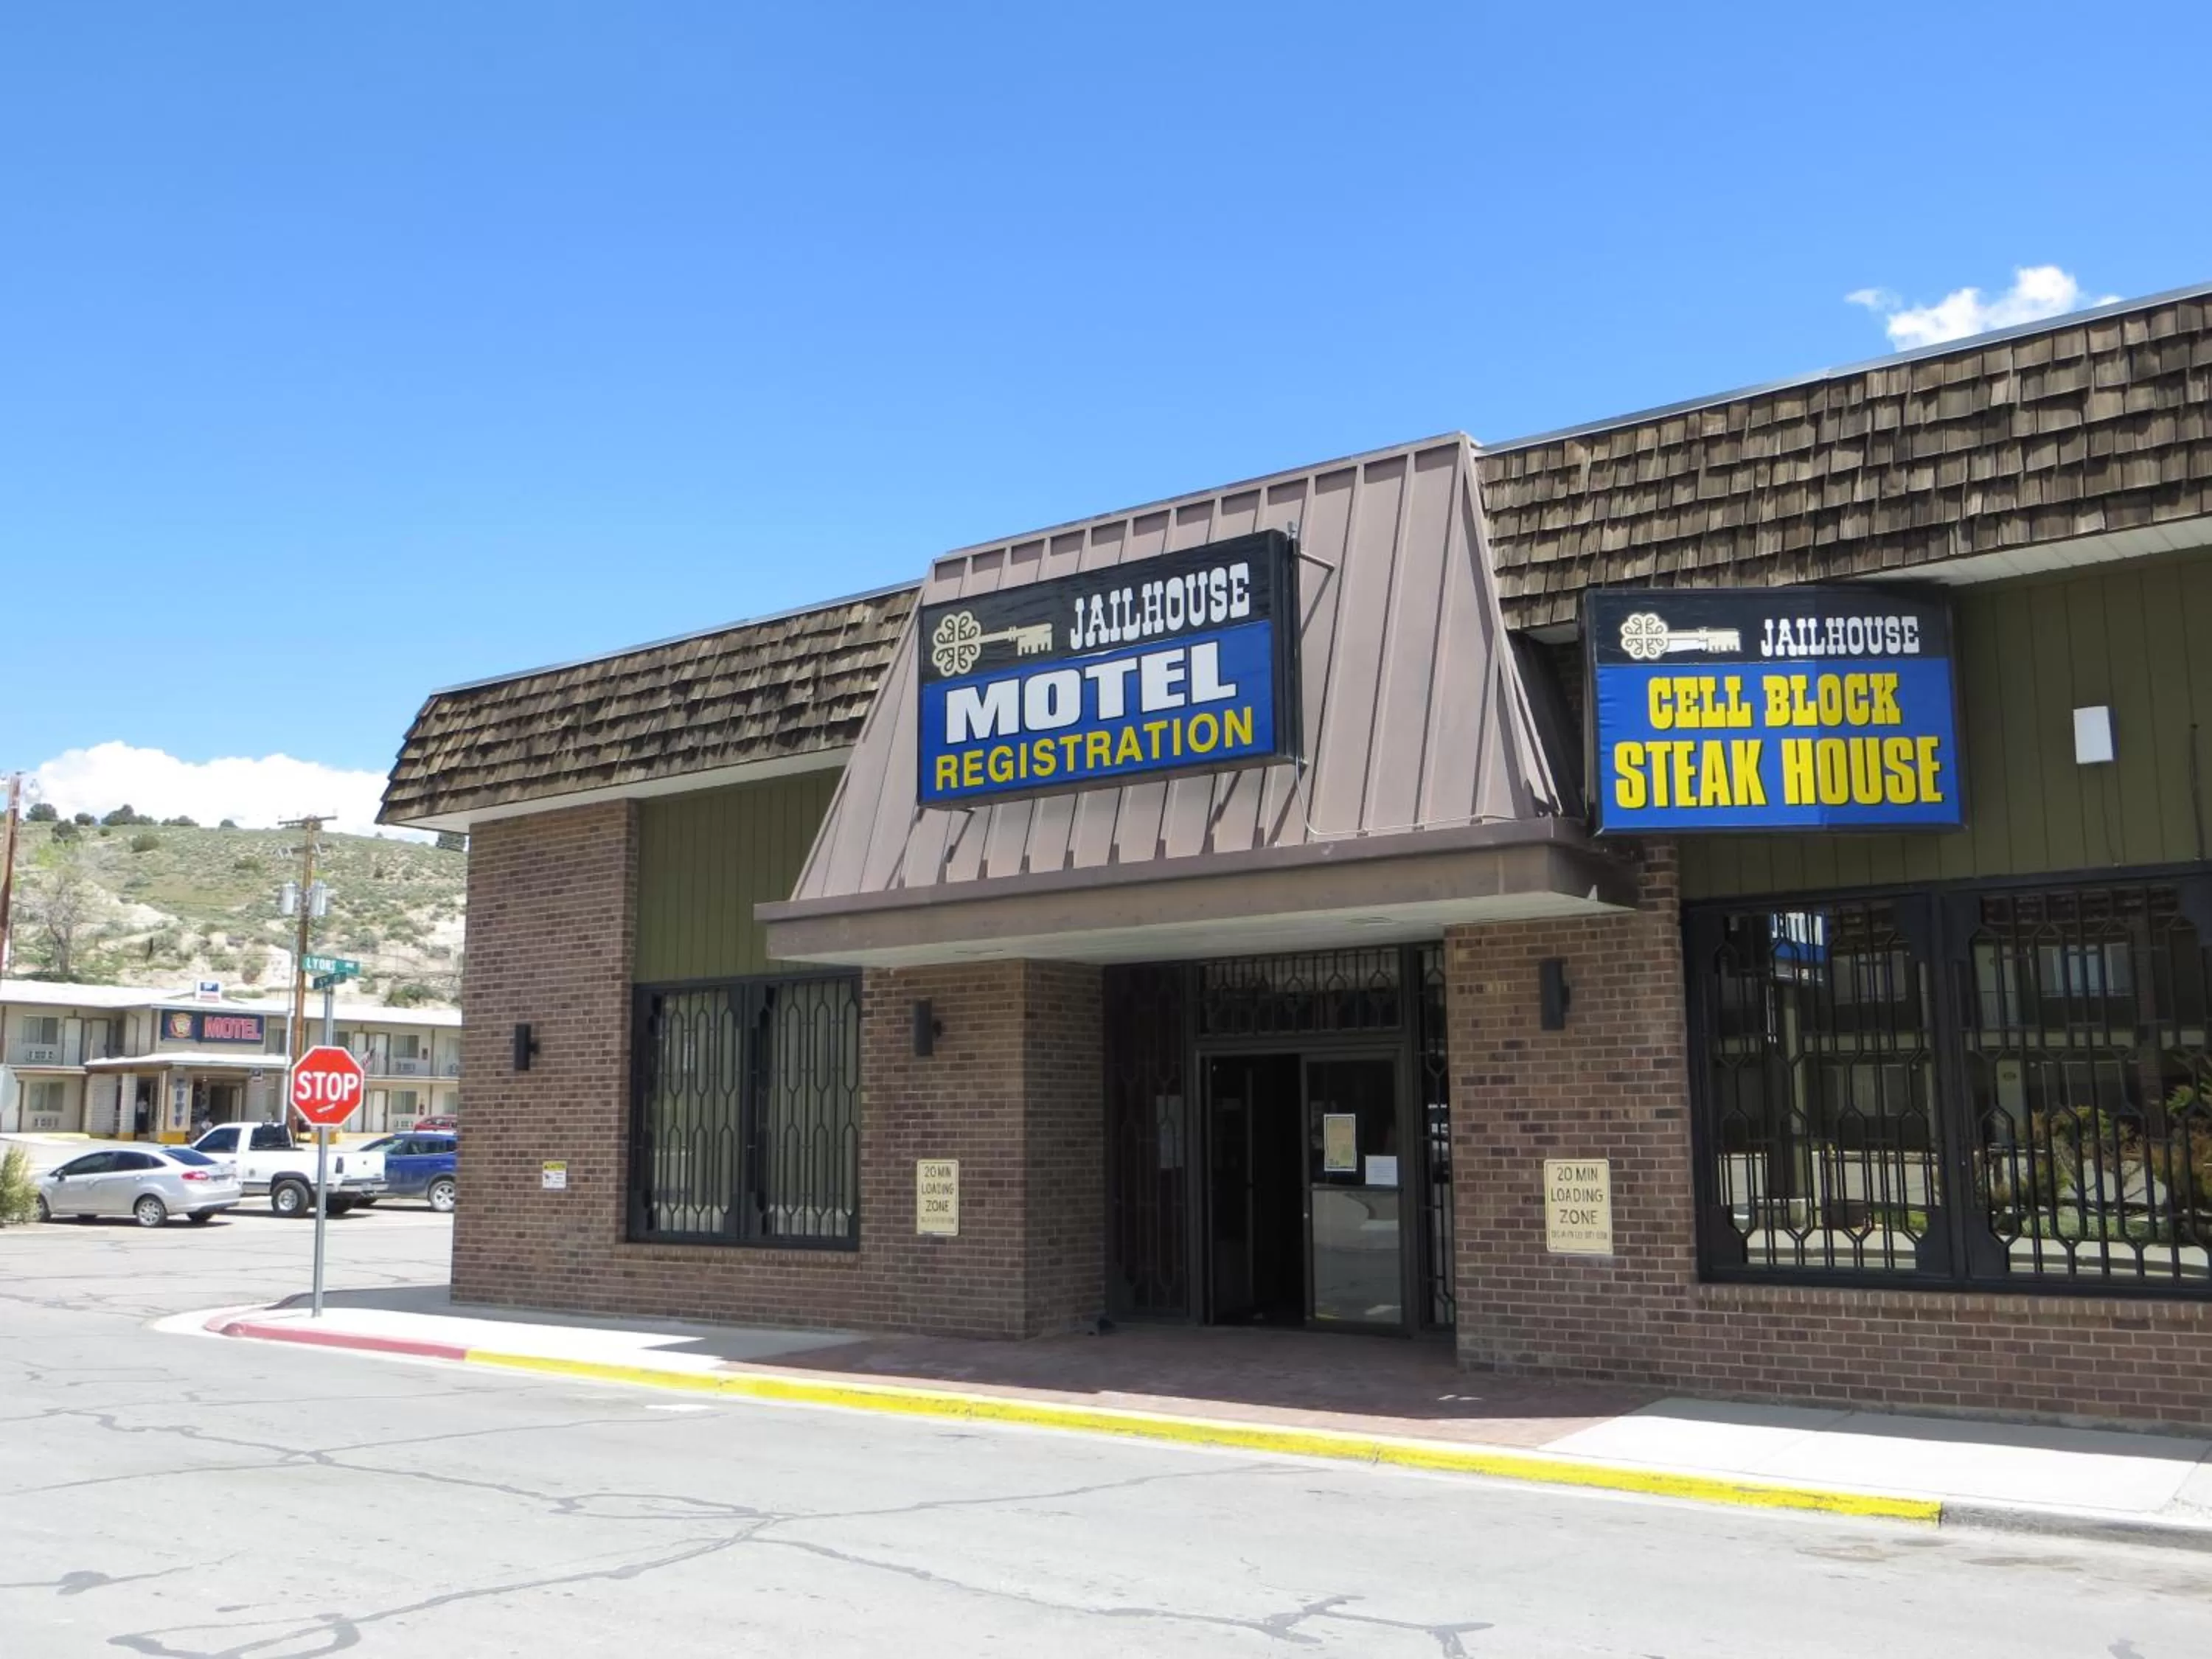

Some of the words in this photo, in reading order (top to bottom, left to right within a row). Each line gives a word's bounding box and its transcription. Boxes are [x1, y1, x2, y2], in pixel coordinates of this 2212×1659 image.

[1070, 563, 1250, 650] JAILHOUSE
[1760, 616, 1920, 658] JAILHOUSE
[945, 641, 1237, 745] MOTEL
[1647, 675, 1753, 729] CELL
[1762, 672, 1901, 726] BLOCK
[935, 706, 1253, 791] REGISTRATION
[1614, 739, 1767, 809] STEAK
[1781, 736, 1944, 805] HOUSE
[204, 1015, 261, 1040] MOTEL
[296, 1071, 359, 1102] STOP
[924, 1166, 936, 1178] 20
[1557, 1166, 1573, 1182] 20
[1576, 1167, 1599, 1182] MIN
[925, 1200, 950, 1212] ZONE
[1551, 1188, 1604, 1203] LOADING
[1559, 1209, 1599, 1225] ZONE
